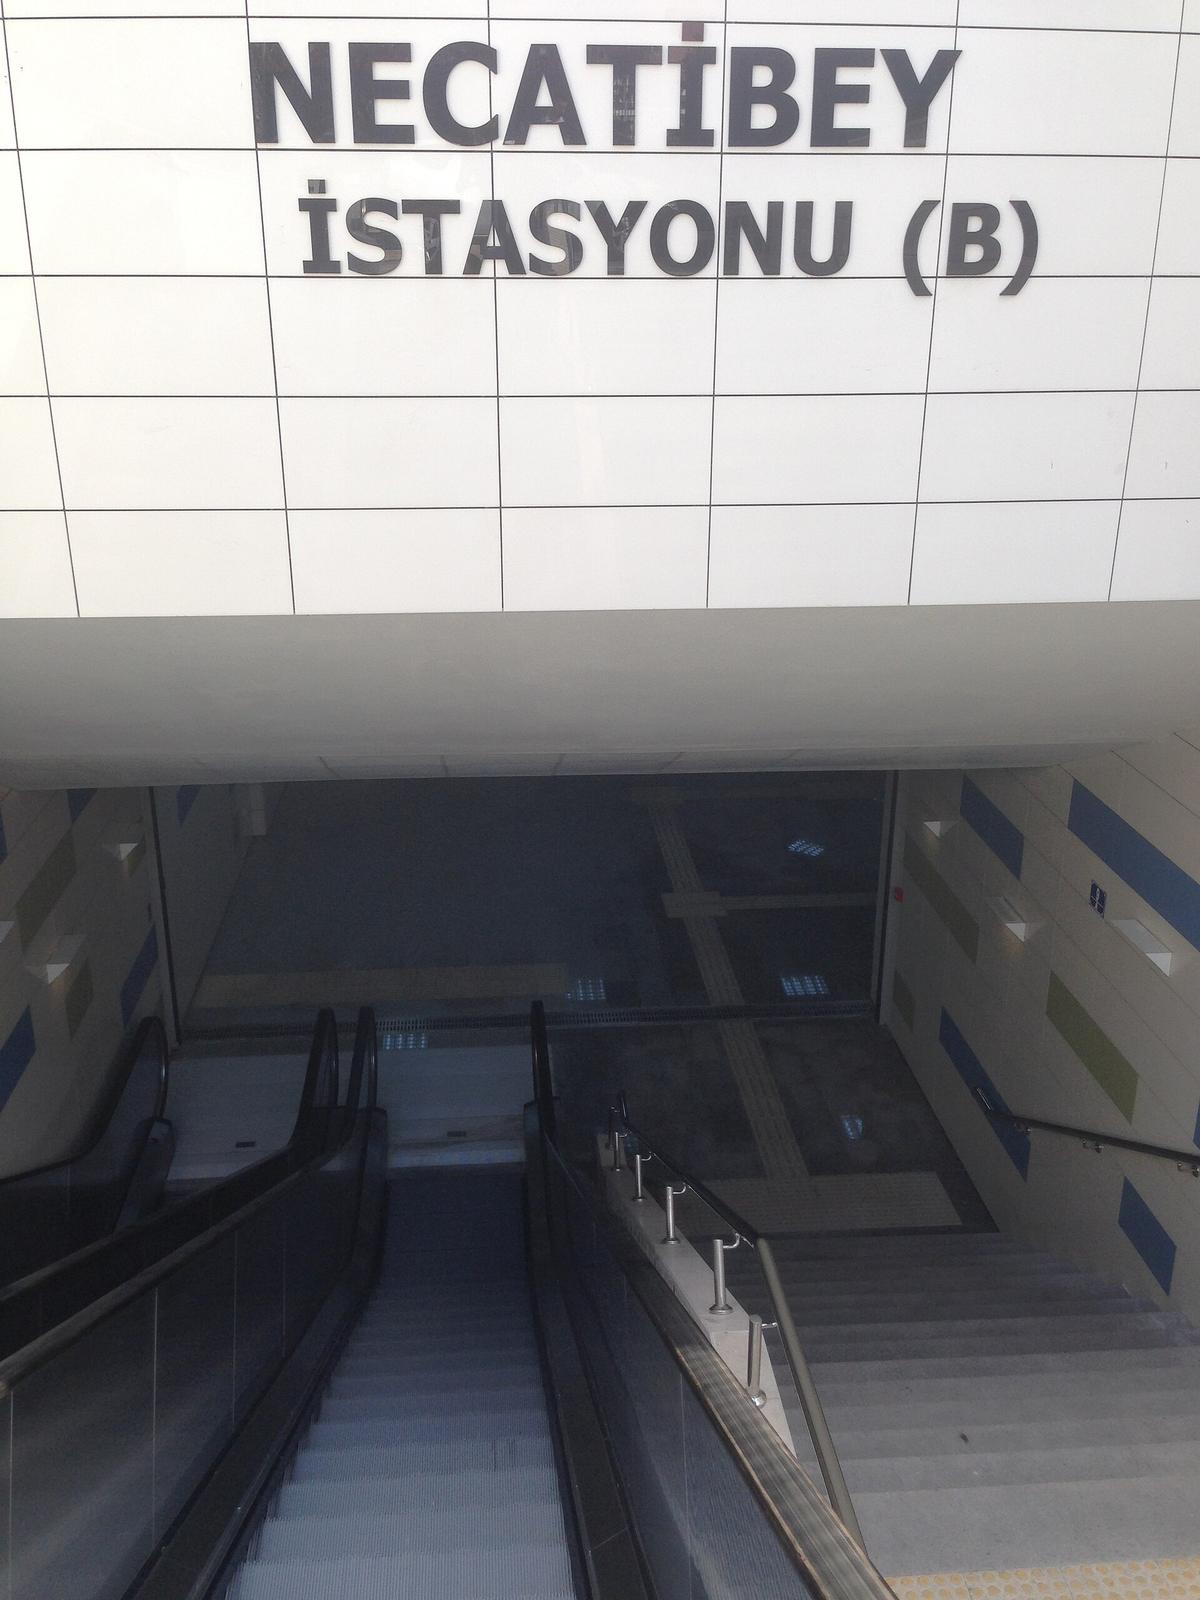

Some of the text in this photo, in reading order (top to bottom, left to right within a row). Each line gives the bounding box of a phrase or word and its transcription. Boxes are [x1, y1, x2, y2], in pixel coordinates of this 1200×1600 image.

[249, 22, 962, 148] NECATİBEY
[298, 179, 1039, 297] İSTASYONU (B)
